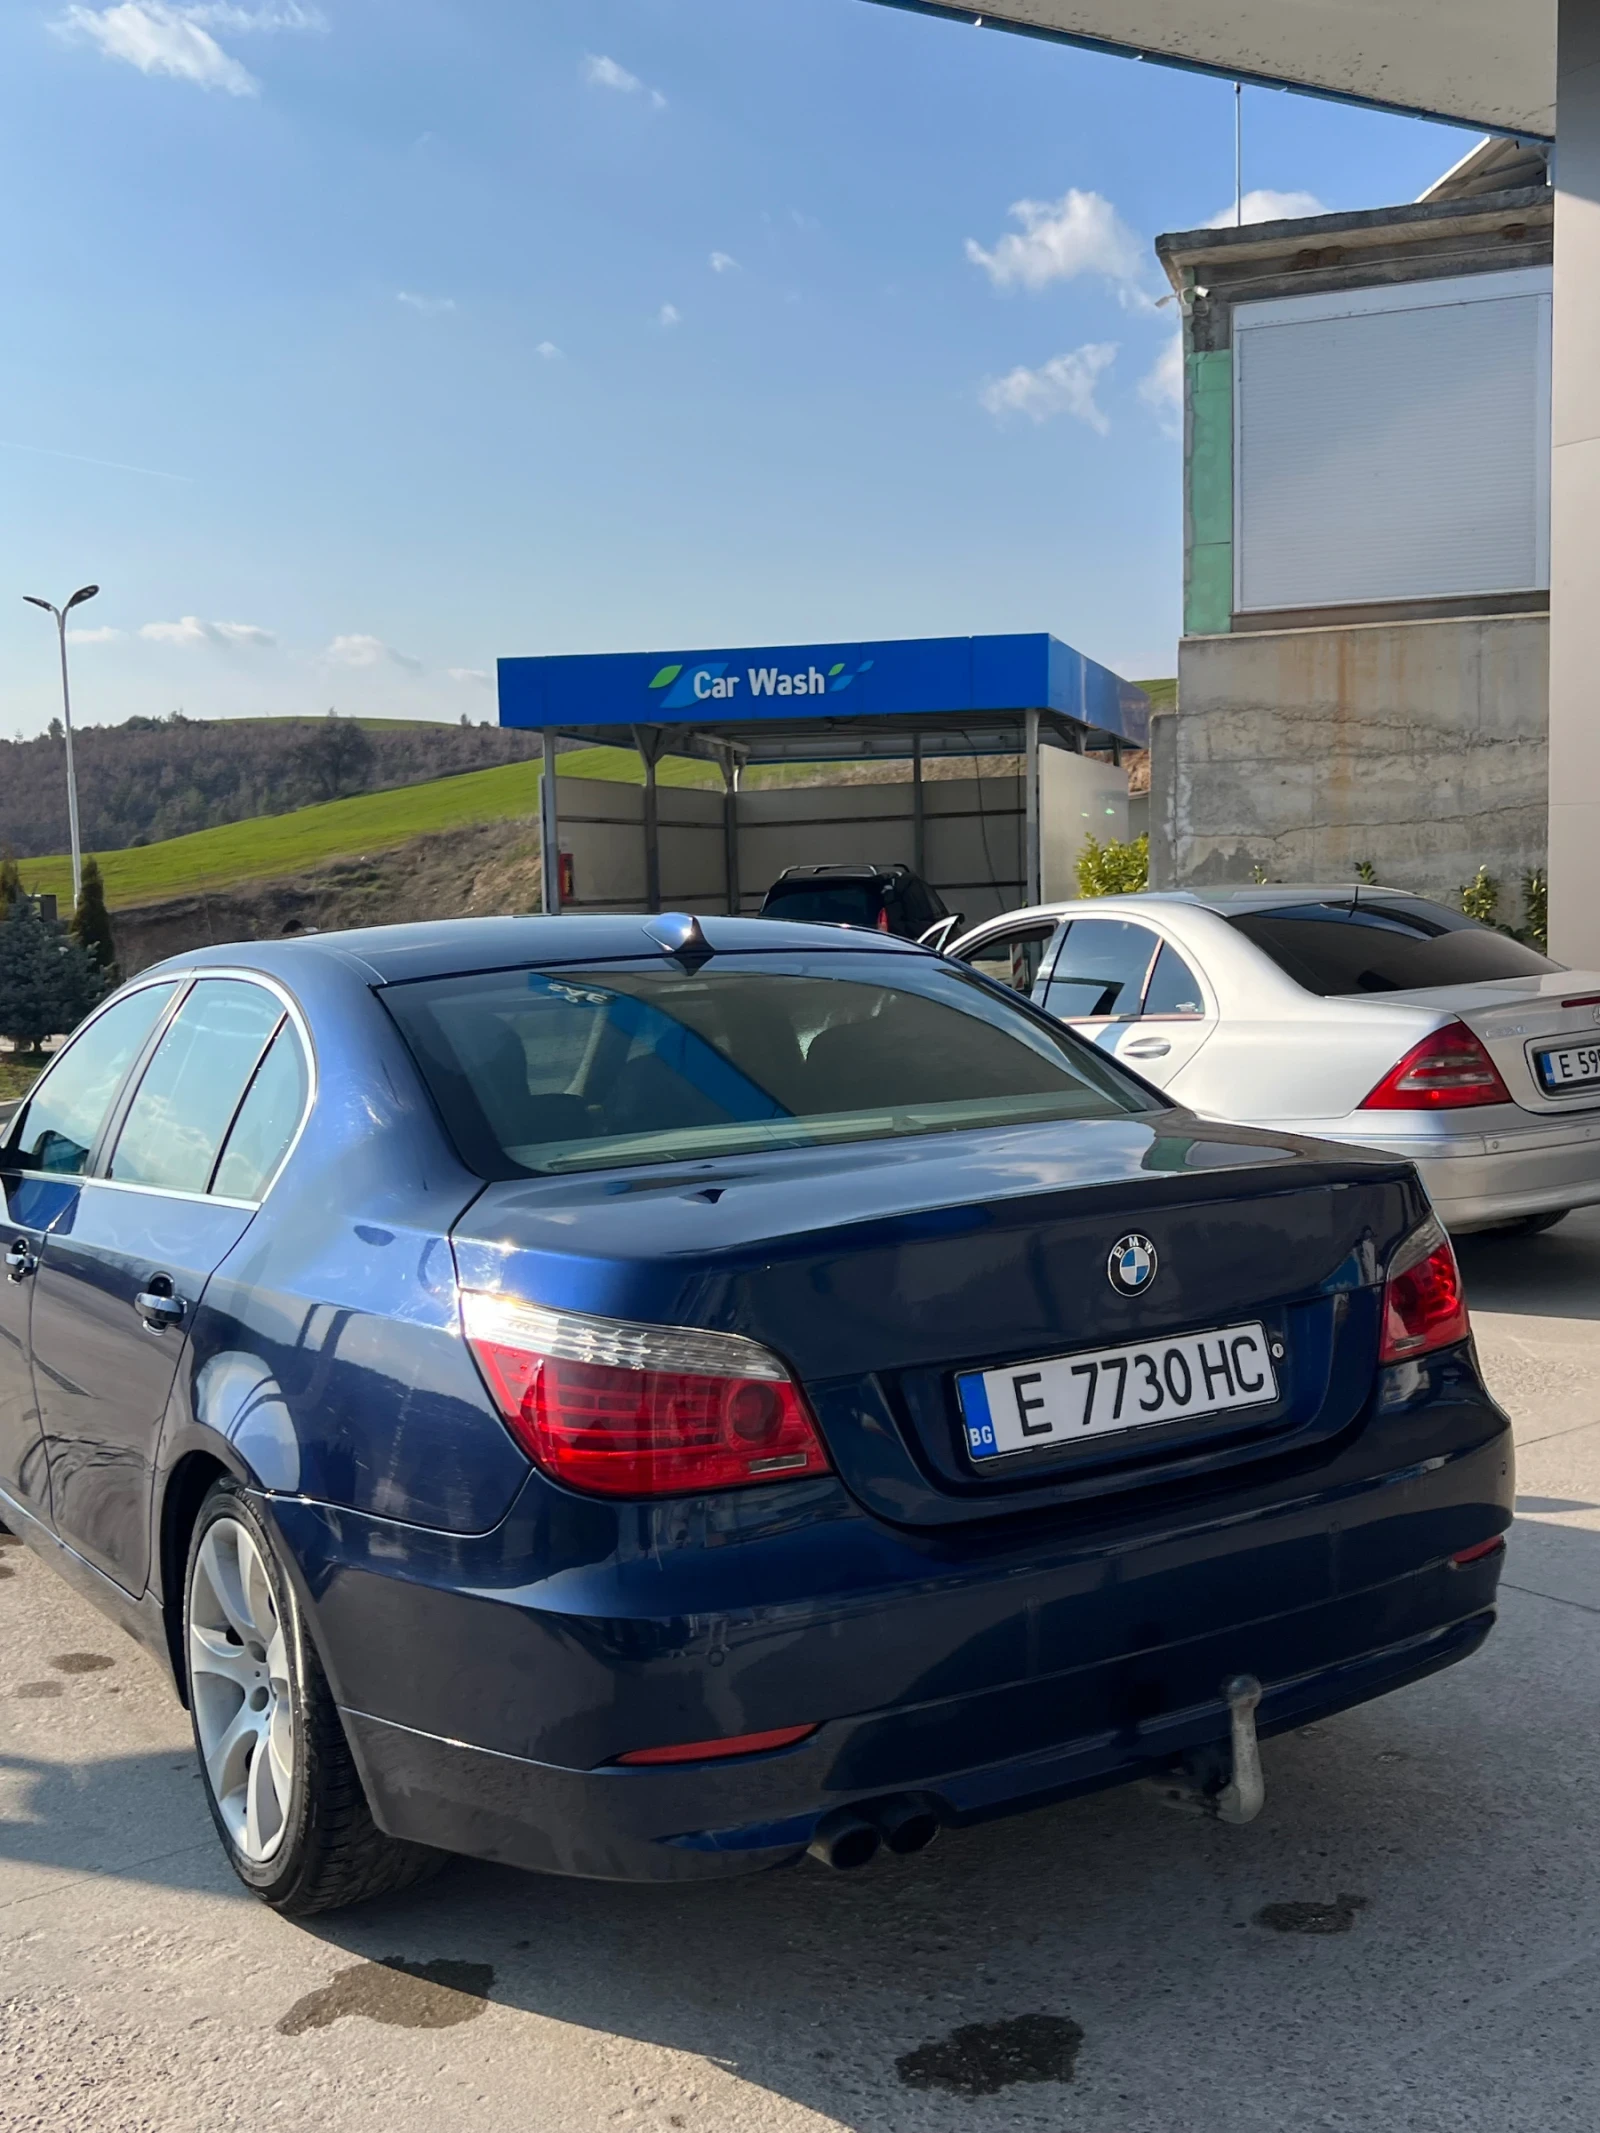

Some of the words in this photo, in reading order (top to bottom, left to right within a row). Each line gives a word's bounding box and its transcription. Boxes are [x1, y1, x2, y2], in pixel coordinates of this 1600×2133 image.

[693, 670, 740, 699] Car
[748, 666, 825, 696] Wash
[1559, 1054, 1573, 1078] E
[1577, 1049, 1600, 1075] 59
[1113, 1236, 1153, 1259] BMW
[1012, 1372, 1053, 1437] E
[1071, 1348, 1192, 1426] 7730
[1197, 1336, 1265, 1401] HC
[969, 1425, 993, 1447] BG
